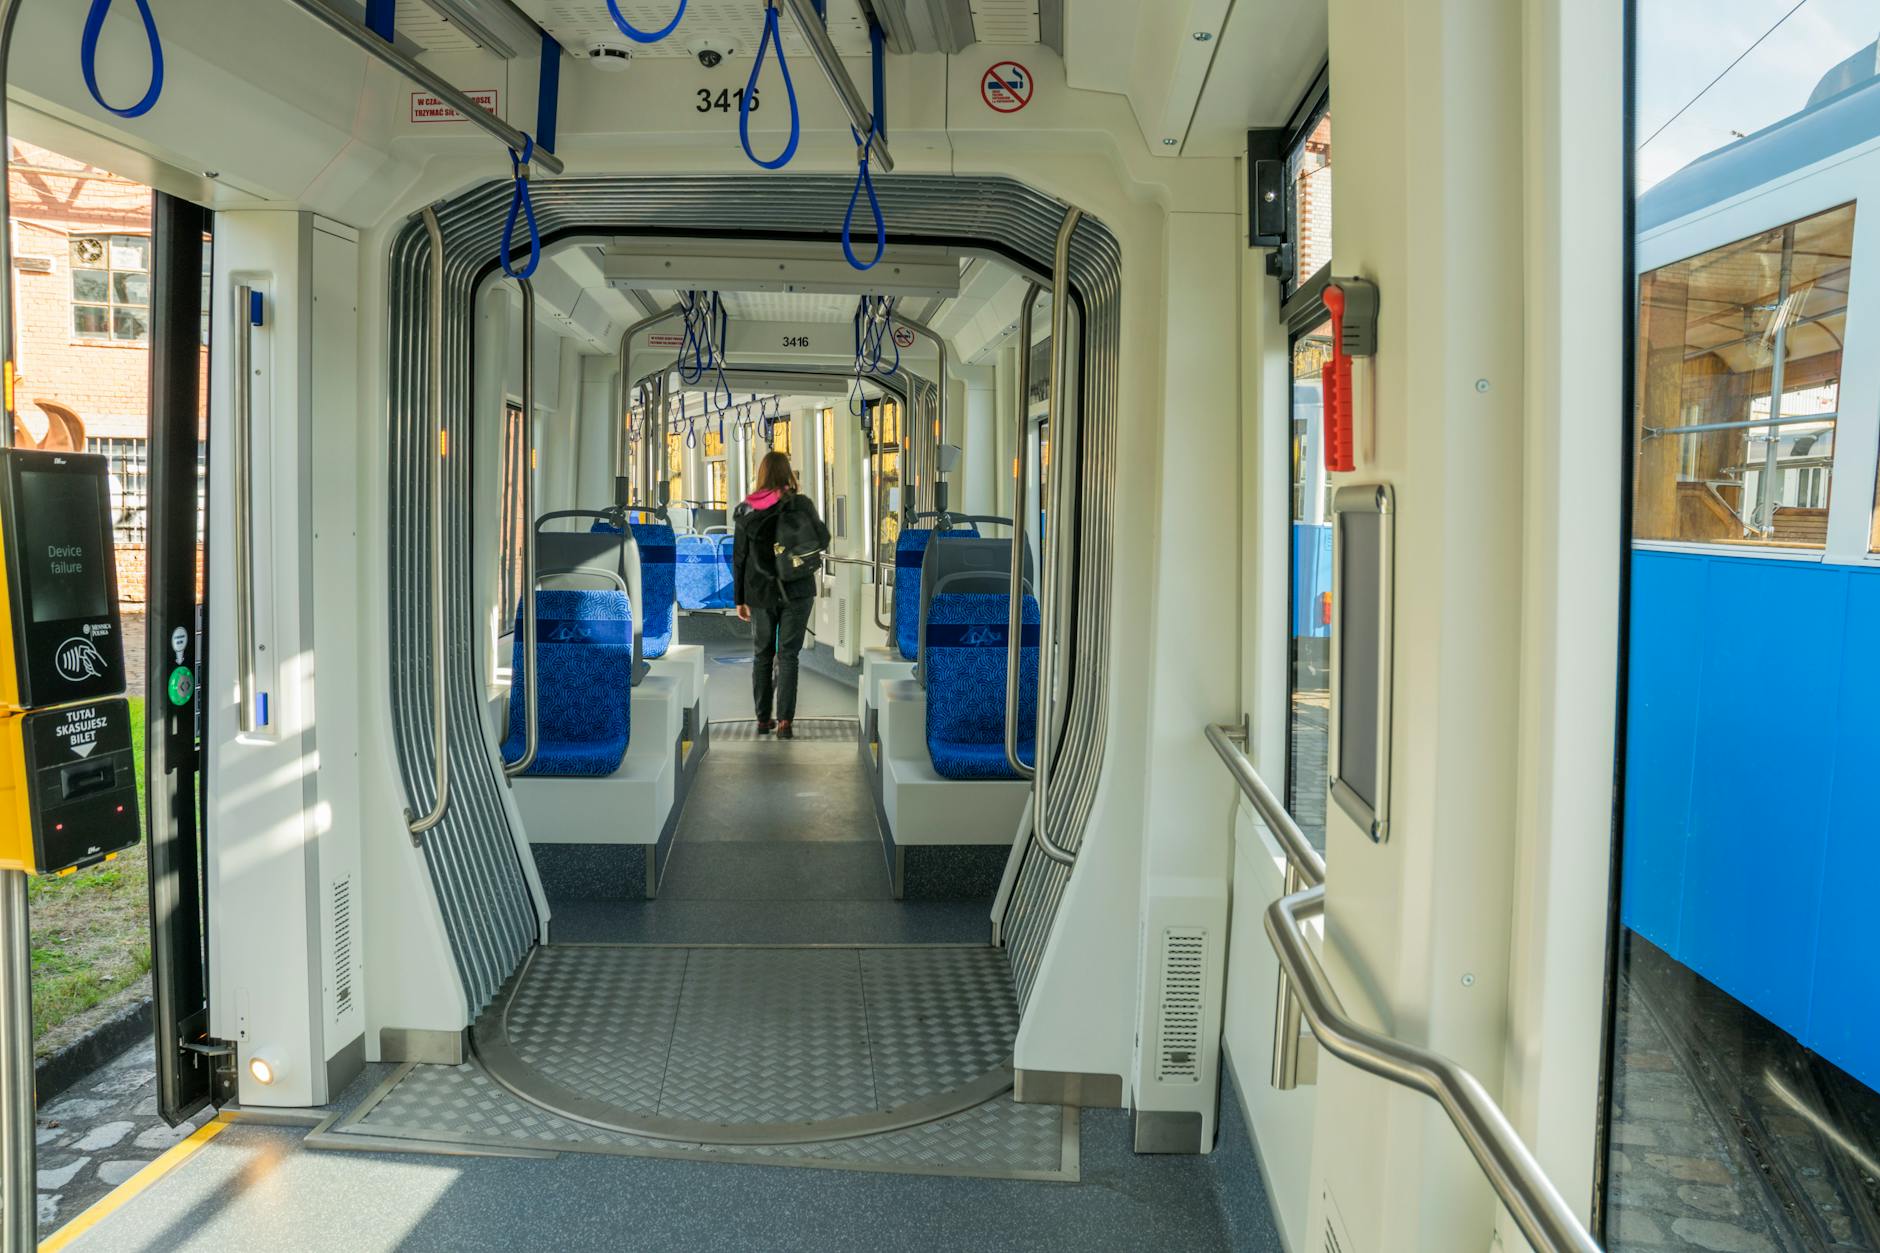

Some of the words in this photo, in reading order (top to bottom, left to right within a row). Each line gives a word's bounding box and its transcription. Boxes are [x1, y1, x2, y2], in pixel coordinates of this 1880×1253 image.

[417, 98, 425, 106] W
[696, 88, 759, 112] 3416
[782, 336, 809, 347] 3416
[48, 545, 82, 558] Device
[51, 561, 82, 574] failure
[66, 708, 96, 723] TUTAJ
[56, 717, 107, 737] SKASUJESZ
[70, 730, 96, 745] BILET
